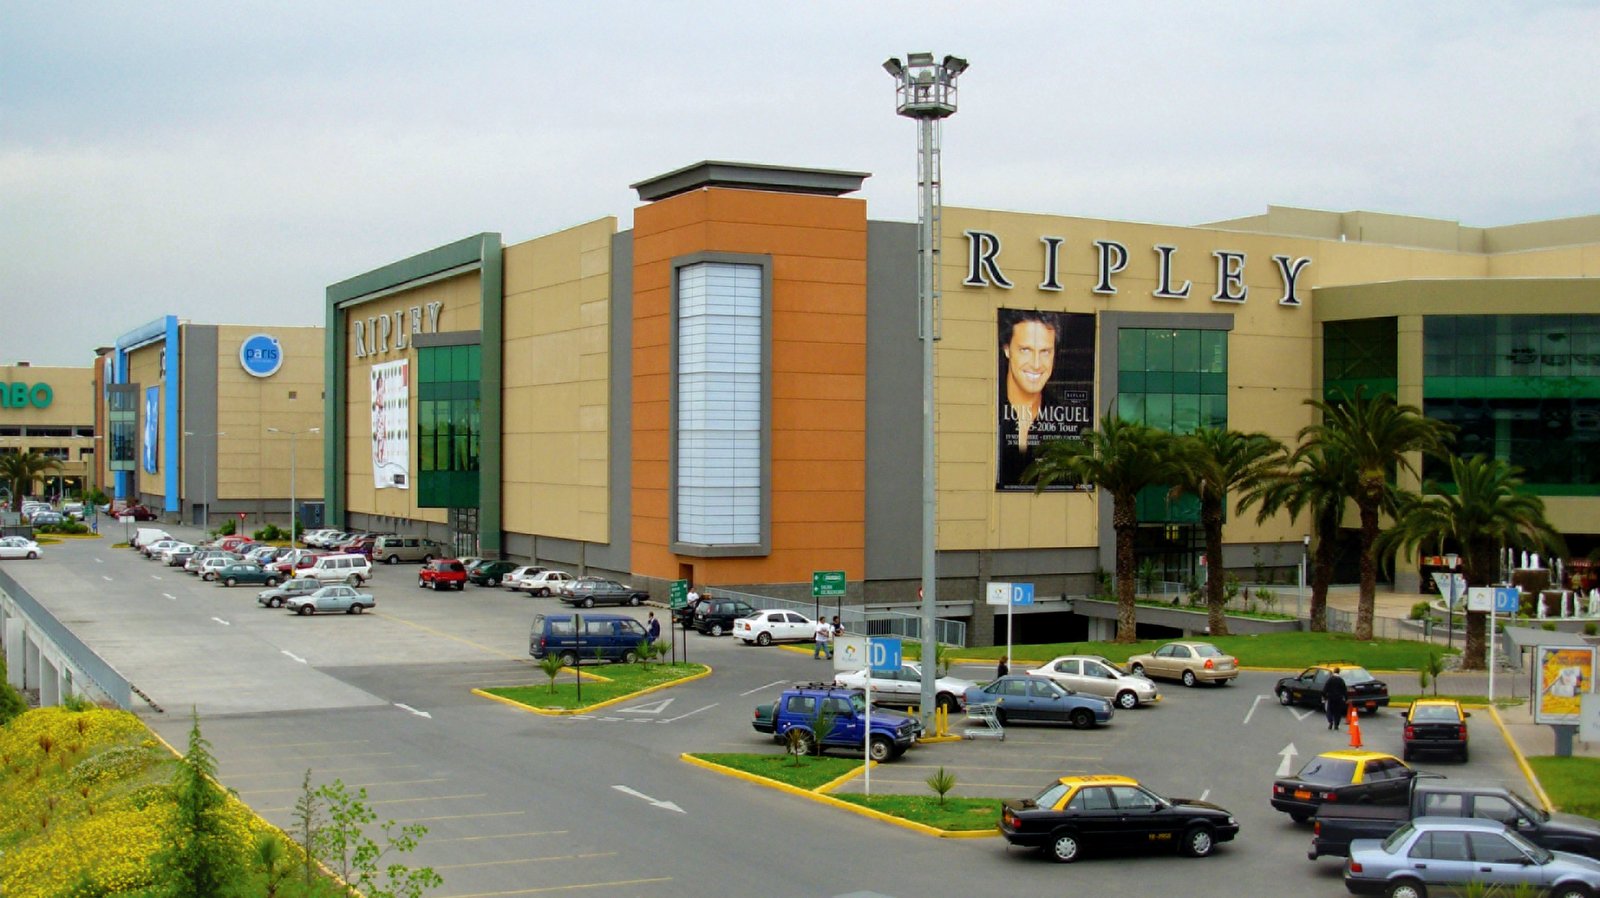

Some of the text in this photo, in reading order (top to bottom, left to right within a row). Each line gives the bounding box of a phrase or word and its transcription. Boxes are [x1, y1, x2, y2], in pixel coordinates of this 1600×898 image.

[962, 229, 1312, 306] RIPLEY
[354, 301, 442, 357] RIPLEY
[246, 348, 277, 361] paris
[1003, 404, 1090, 422] LUIS MIGUEL
[1015, 422, 1078, 432] 25-2006 Tour
[1014, 586, 1031, 602] D 1
[1497, 591, 1516, 608] D 2
[873, 642, 898, 667] D 1
